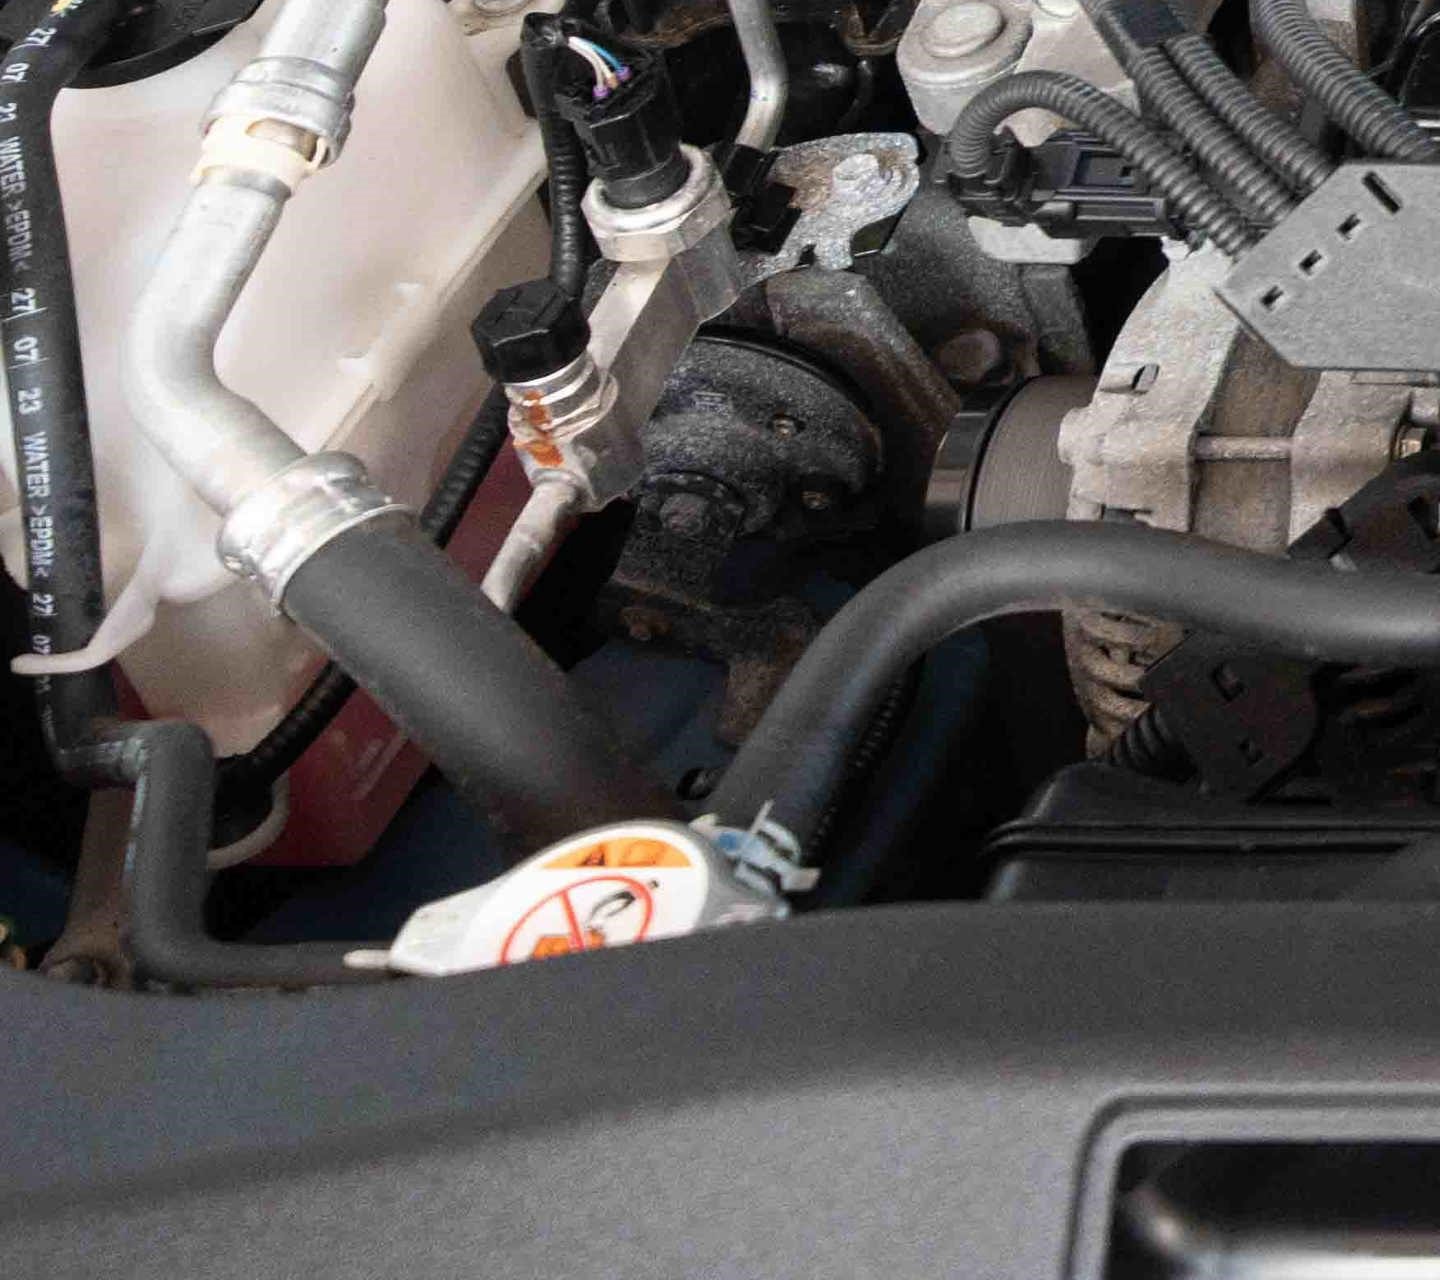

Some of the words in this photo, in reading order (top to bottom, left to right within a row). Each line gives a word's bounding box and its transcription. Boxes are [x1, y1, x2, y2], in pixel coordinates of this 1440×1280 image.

[0, 136, 27, 199] WATER
[17, 387, 42, 416] 23
[23, 431, 51, 498] WATER
